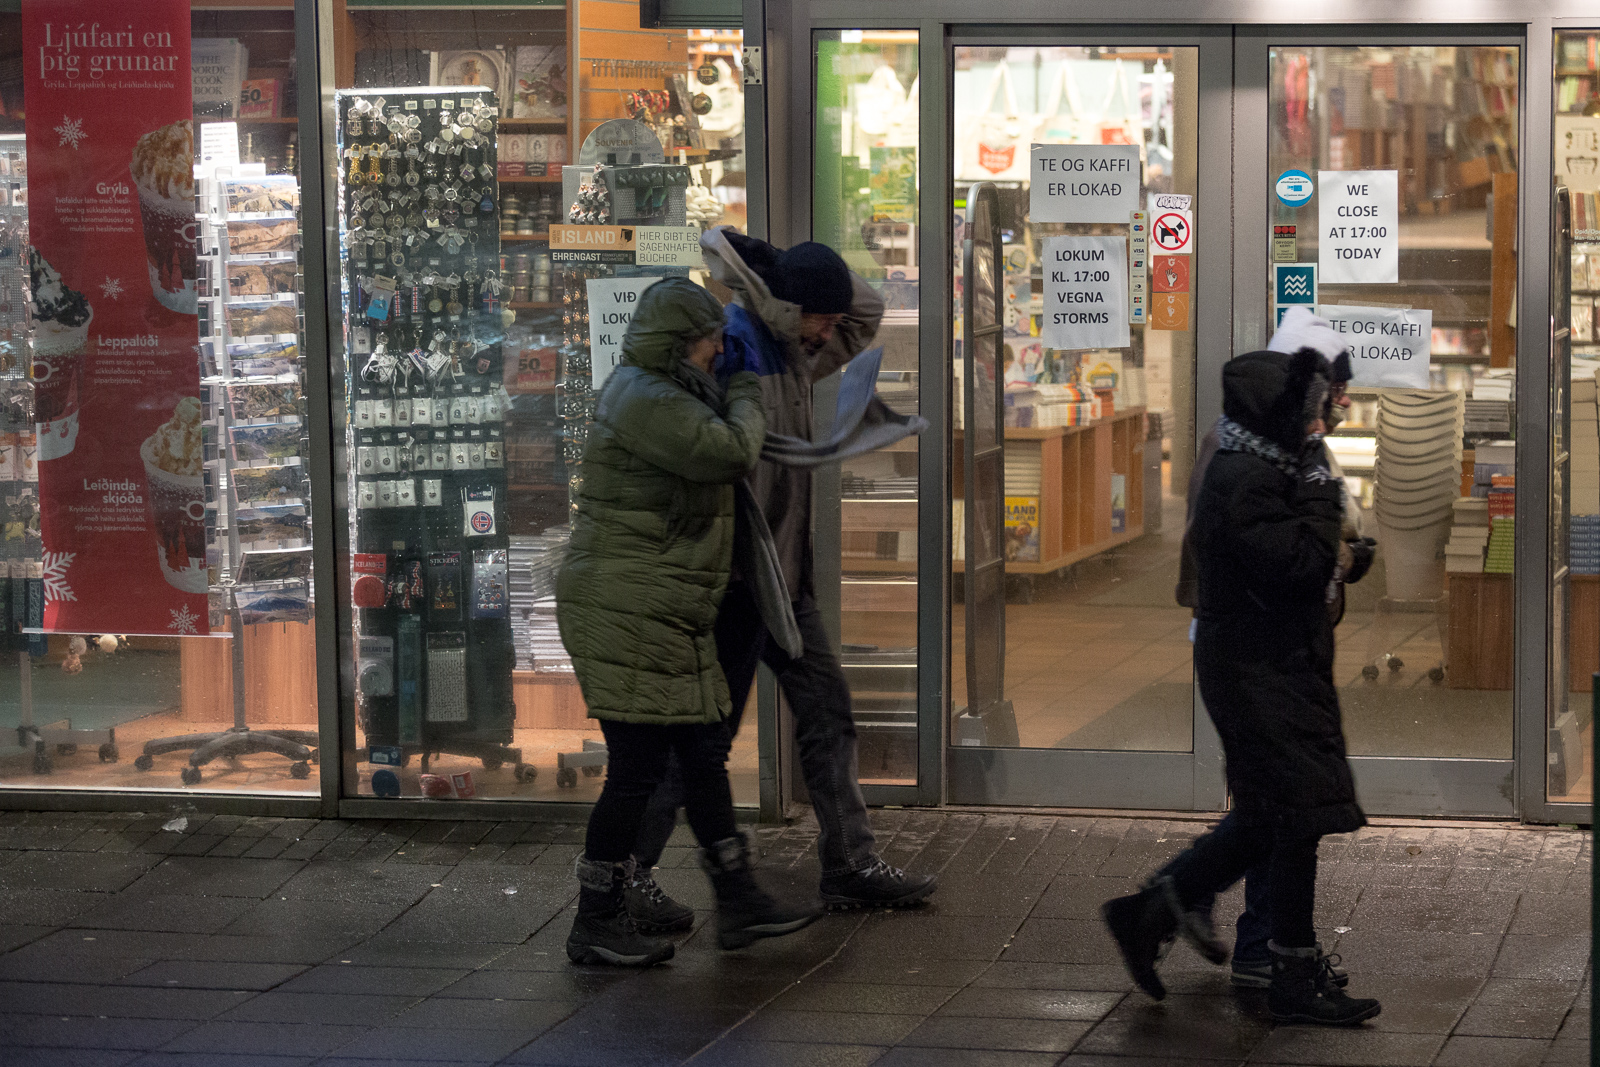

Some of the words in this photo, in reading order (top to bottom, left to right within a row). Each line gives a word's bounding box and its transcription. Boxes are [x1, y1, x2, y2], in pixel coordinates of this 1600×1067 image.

[44, 22, 135, 56] Ljúfari
[143, 32, 173, 48] en
[39, 46, 80, 80] þig
[90, 55, 179, 80] grunar
[200, 55, 220, 64] THE
[191, 66, 231, 75] NORDIC
[193, 76, 223, 85] COOK
[193, 86, 223, 95] BOOK
[241, 88, 262, 104] 50
[1039, 158, 1057, 172] TE
[1061, 158, 1085, 172] OG
[1089, 158, 1130, 172] KAFFI
[96, 182, 130, 198] Grýla
[1048, 182, 1066, 196] ER
[1071, 182, 1122, 196] LOKAÐ
[1346, 184, 1369, 196] WE
[1337, 205, 1379, 217] CLOSE
[561, 230, 616, 245] ISLAND
[640, 231, 661, 241] HIER
[663, 231, 684, 241] GIBT
[686, 232, 699, 242] ES
[1329, 227, 1347, 238] AT
[1350, 226, 1387, 238] 17:00
[639, 242, 699, 253] SAGENHAFTE
[1334, 247, 1381, 260] TODAY
[552, 252, 602, 261] EHRENGAST
[639, 252, 678, 263] BÜCHER
[1056, 250, 1104, 262] LOKUM
[1052, 271, 1070, 282] KL.
[1074, 270, 1110, 282] 17:00
[613, 291, 637, 303] VIÐ
[1057, 292, 1104, 303] VEGNA
[602, 312, 631, 325] LOK
[1053, 312, 1109, 324] STORMS
[1329, 319, 1347, 333] TE
[1352, 320, 1375, 335] OG
[1380, 322, 1422, 337] KAFFI
[98, 334, 159, 349] Leppalúði
[599, 334, 618, 345] KL.
[1348, 345, 1356, 359] R
[1360, 345, 1413, 361] LOKAÐ
[518, 357, 541, 371] 50
[83, 478, 140, 491] Leiðinda-
[102, 491, 143, 506] skjóða
